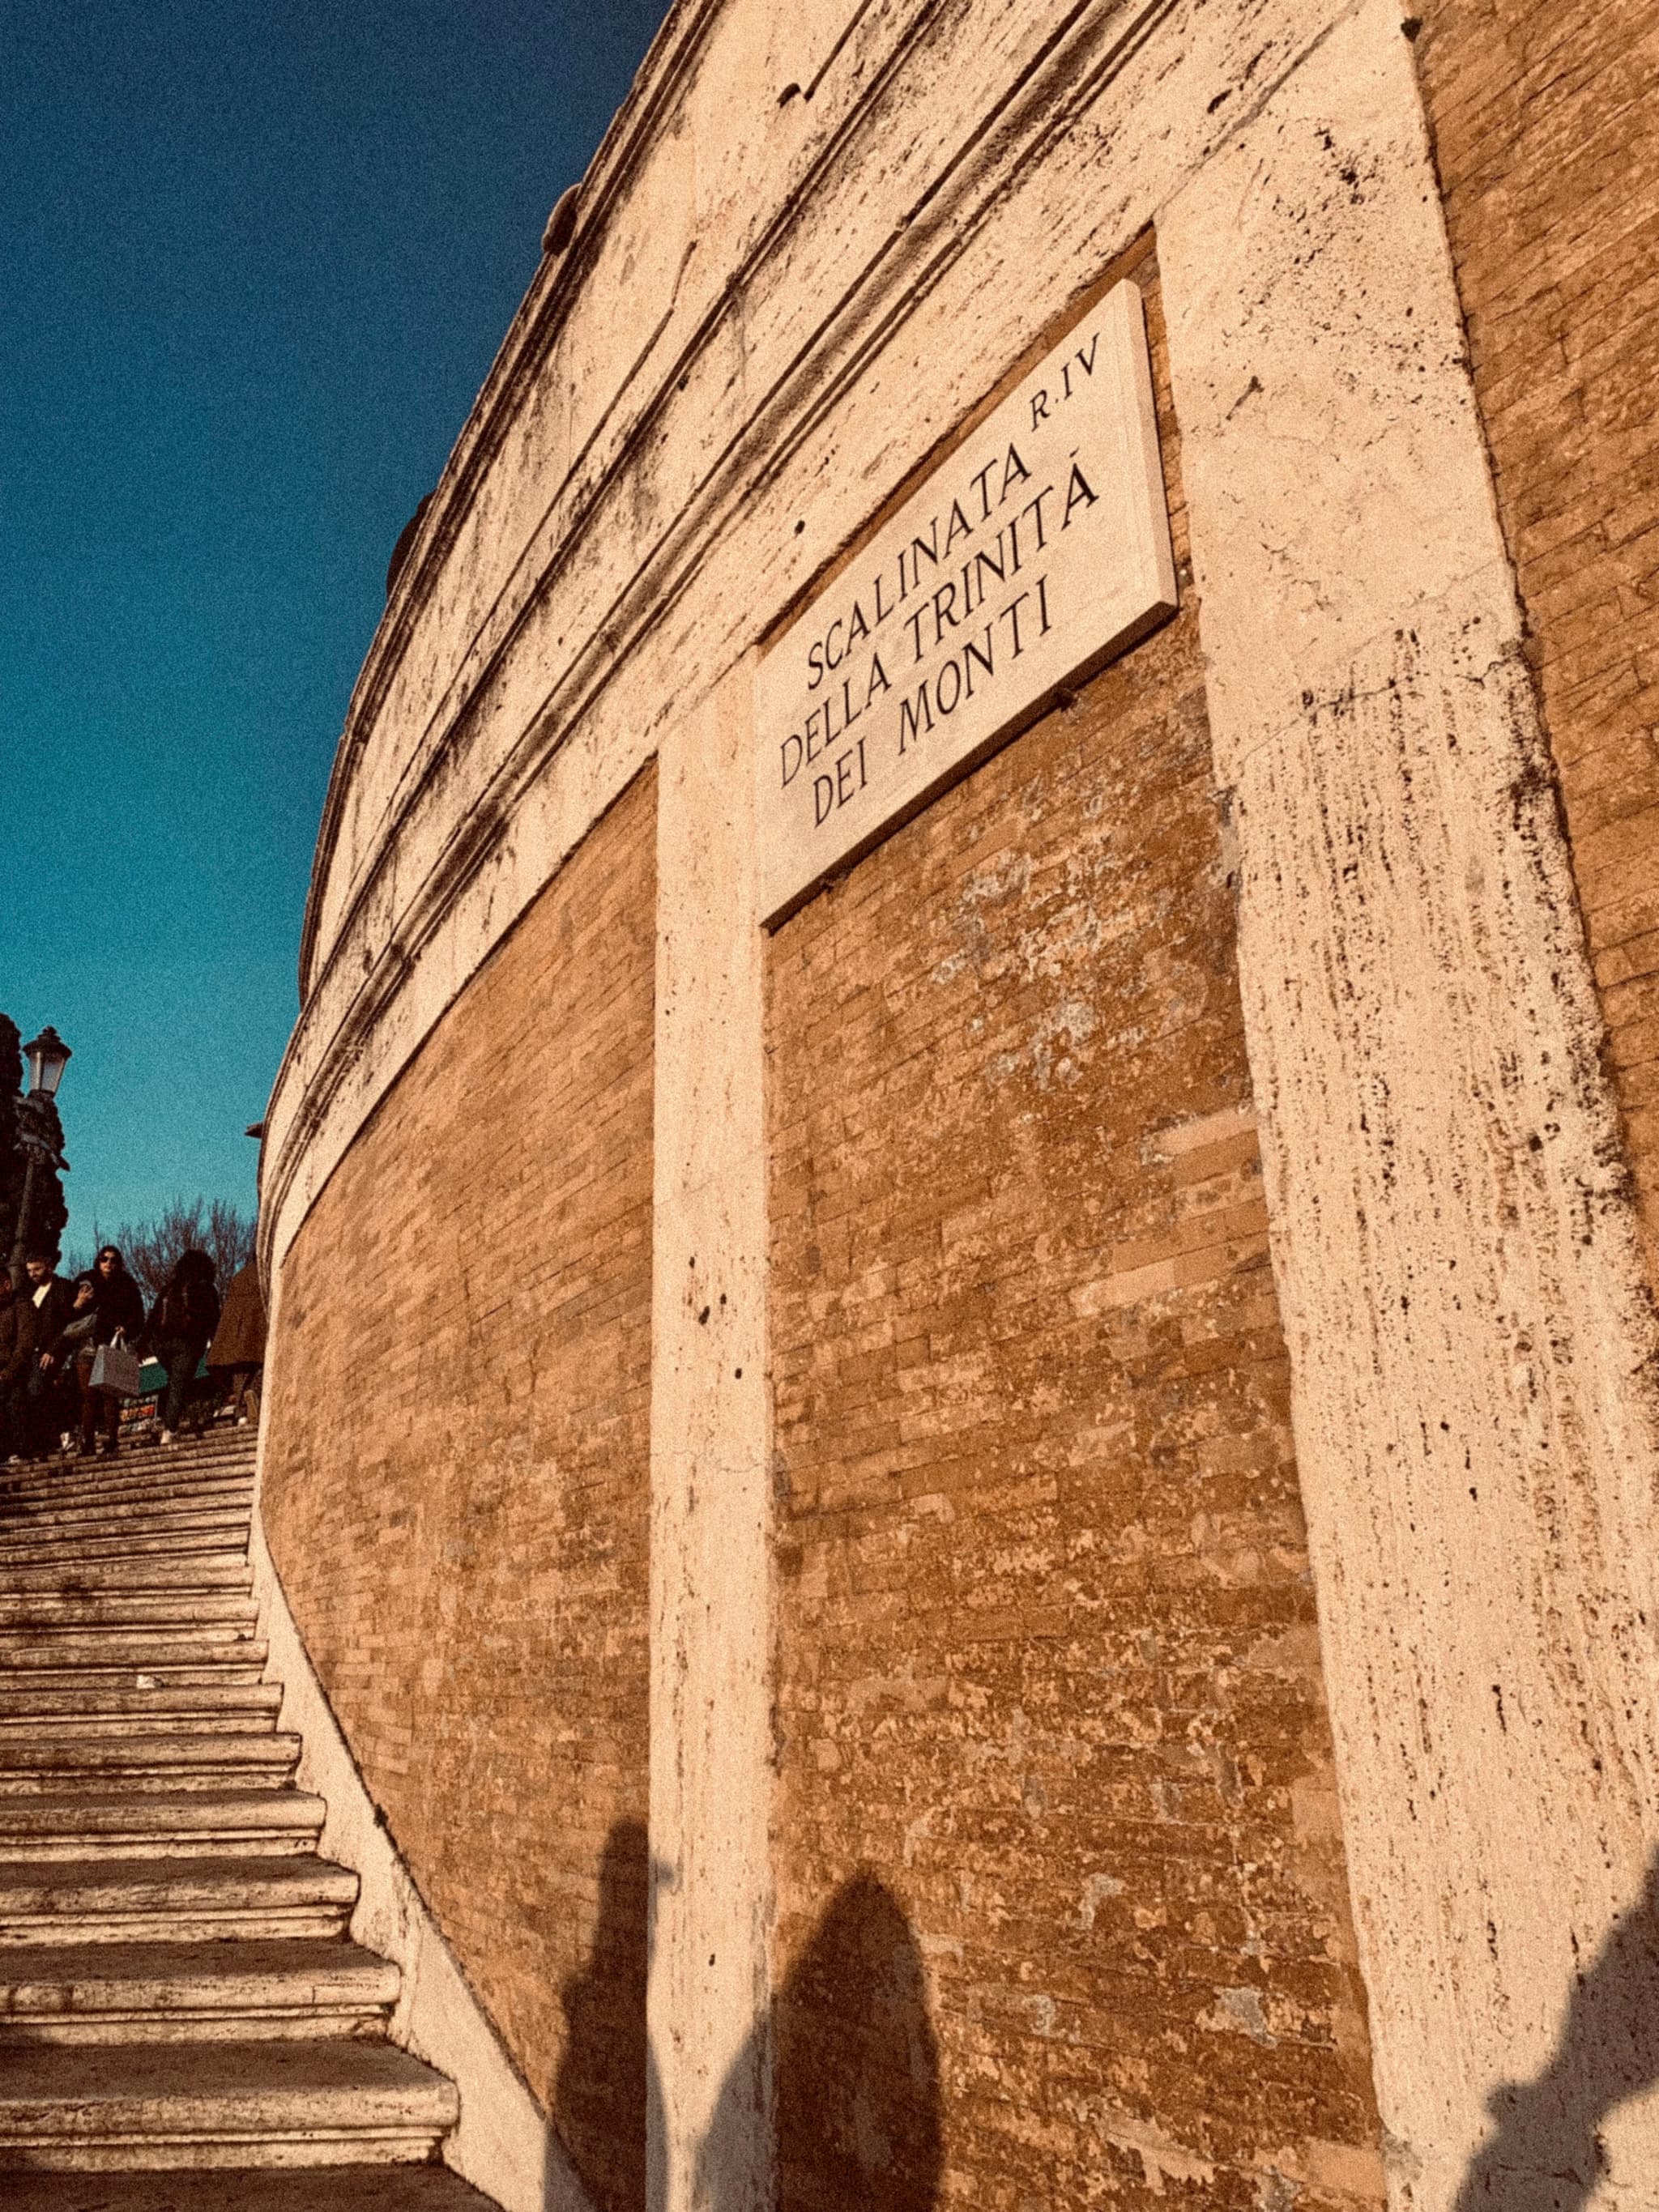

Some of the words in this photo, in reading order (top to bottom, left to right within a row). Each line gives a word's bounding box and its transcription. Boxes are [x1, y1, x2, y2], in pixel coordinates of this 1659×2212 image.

[806, 443, 1032, 690] SCALINATA
[779, 652, 893, 790] DELLA
[814, 739, 868, 829] DEI
[898, 574, 1053, 754] MONTI
